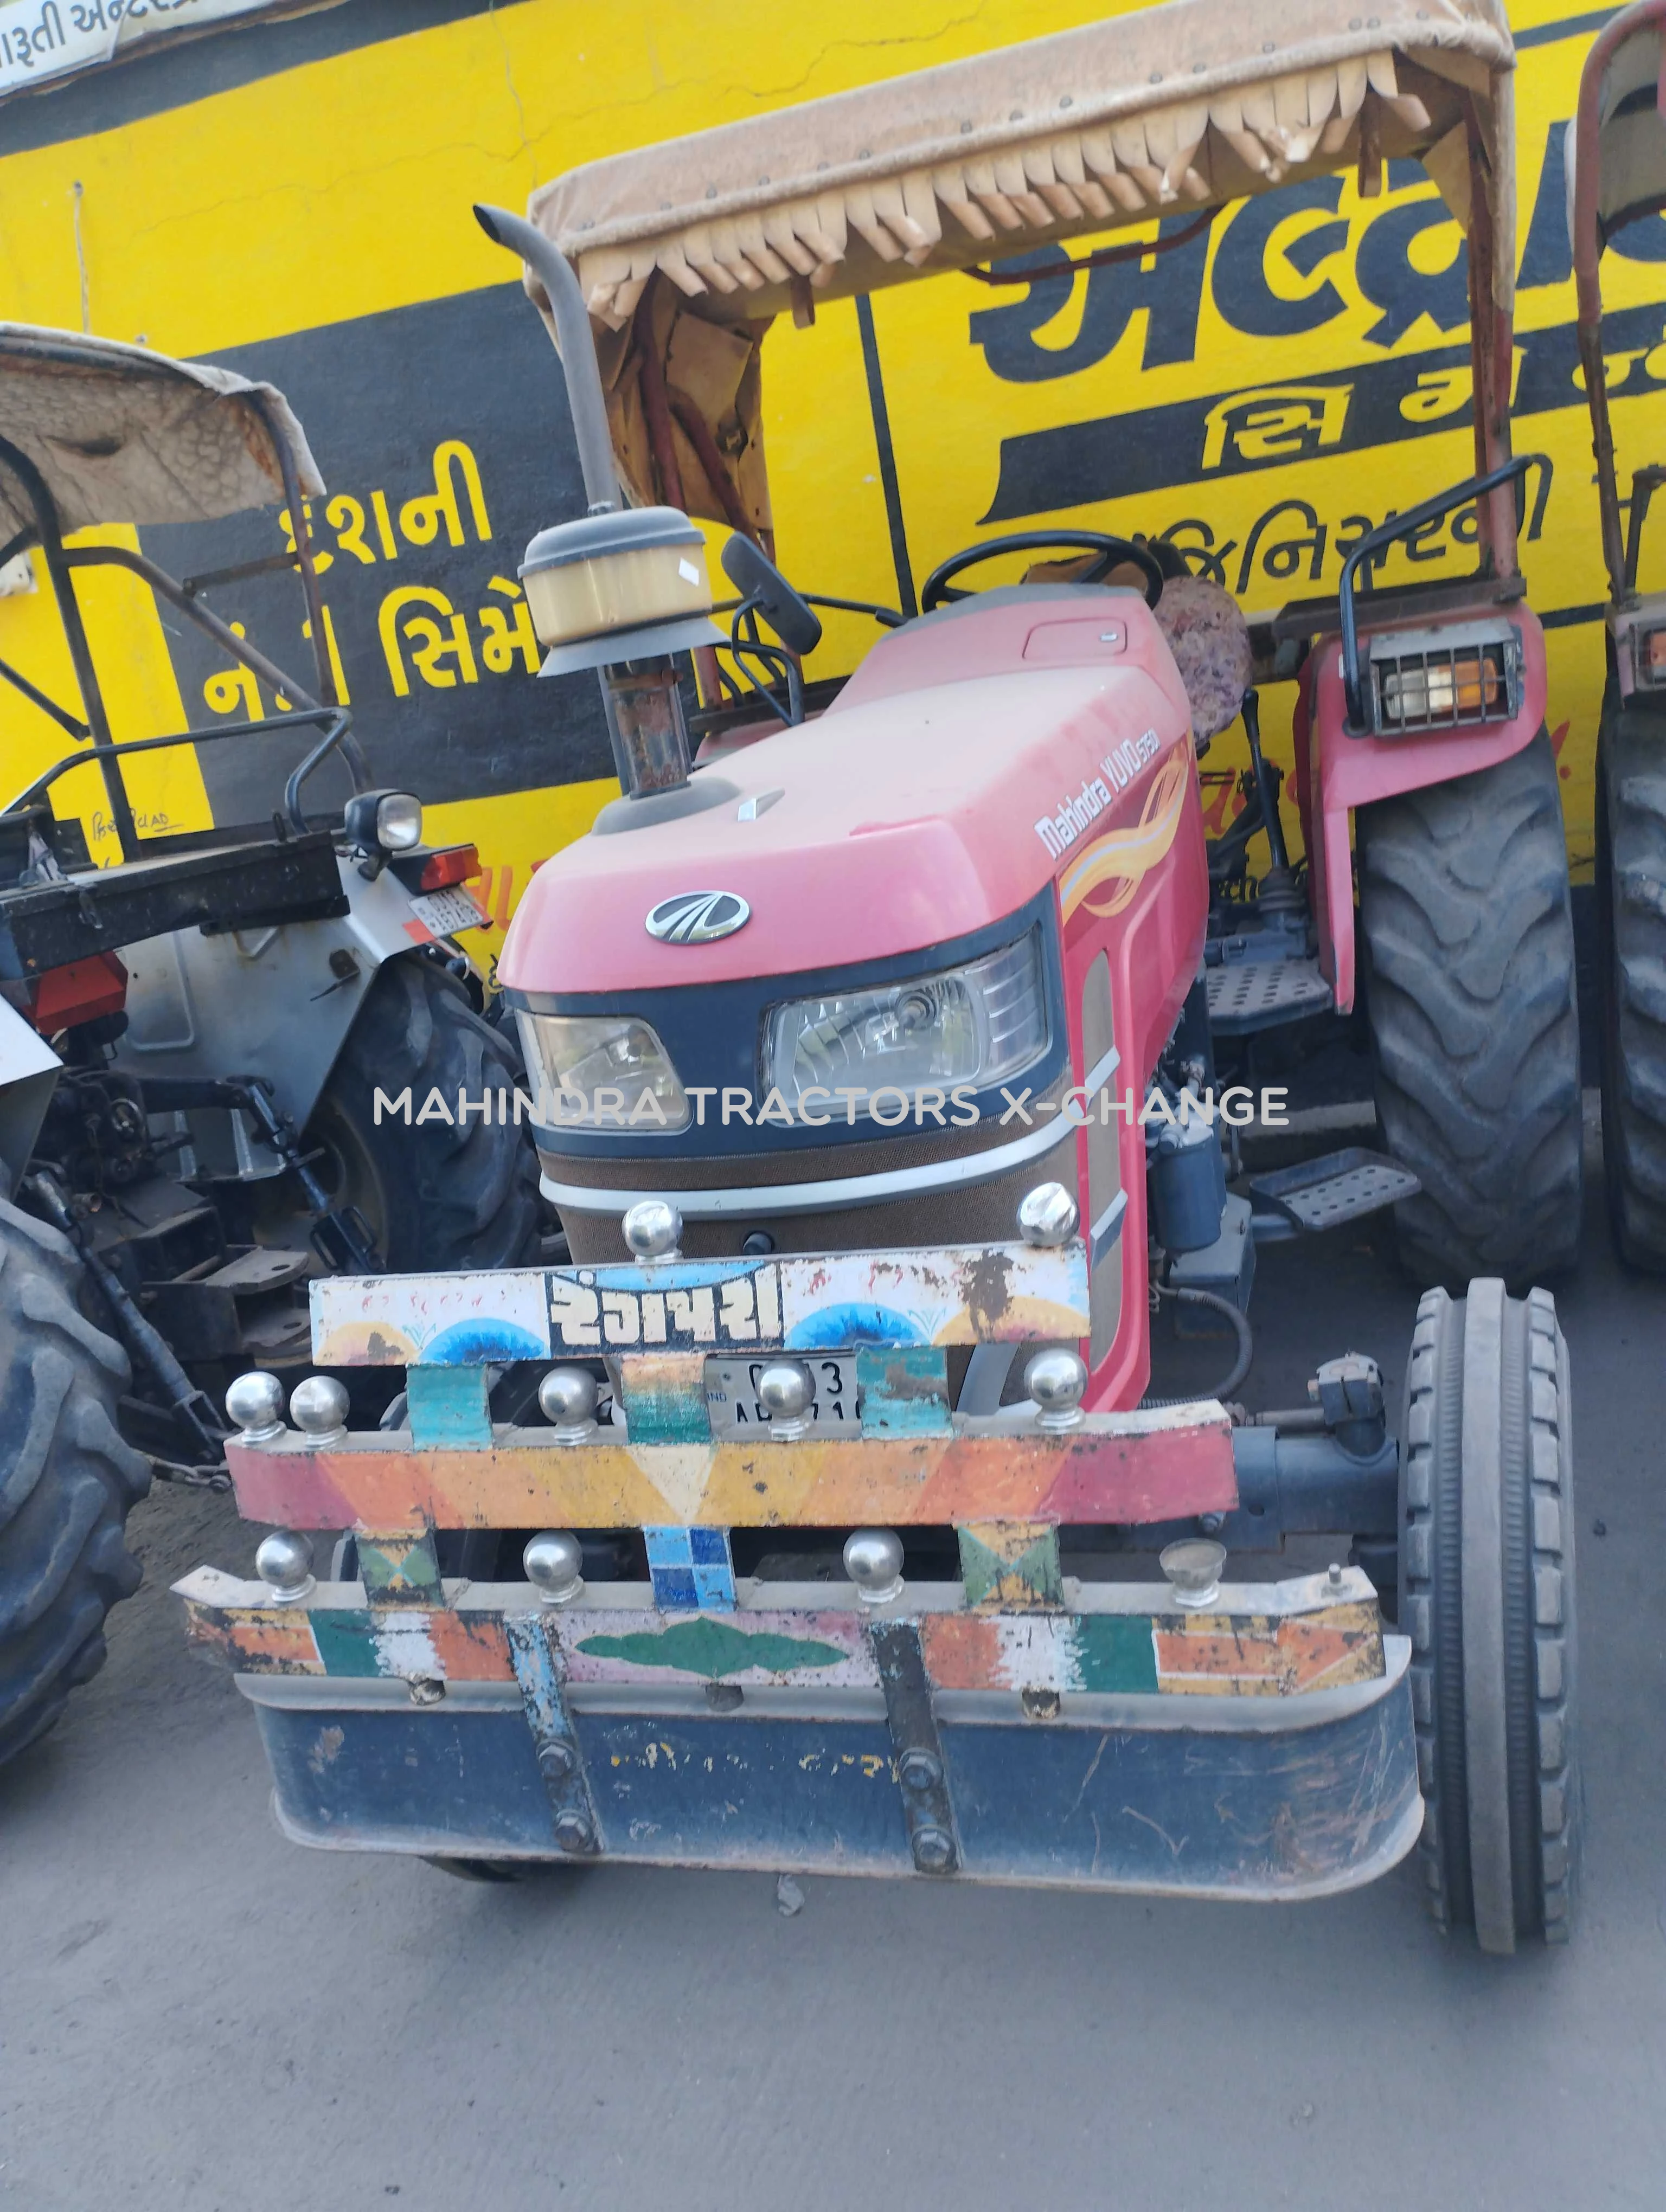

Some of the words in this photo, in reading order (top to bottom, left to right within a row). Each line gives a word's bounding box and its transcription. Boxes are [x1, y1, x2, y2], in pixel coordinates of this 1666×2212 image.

[0, 1, 66, 68] ારૂતી
[1034, 776, 1112, 860] Mahindra
[1099, 738, 1142, 793] YUVO
[707, 1392, 727, 1403] IND
